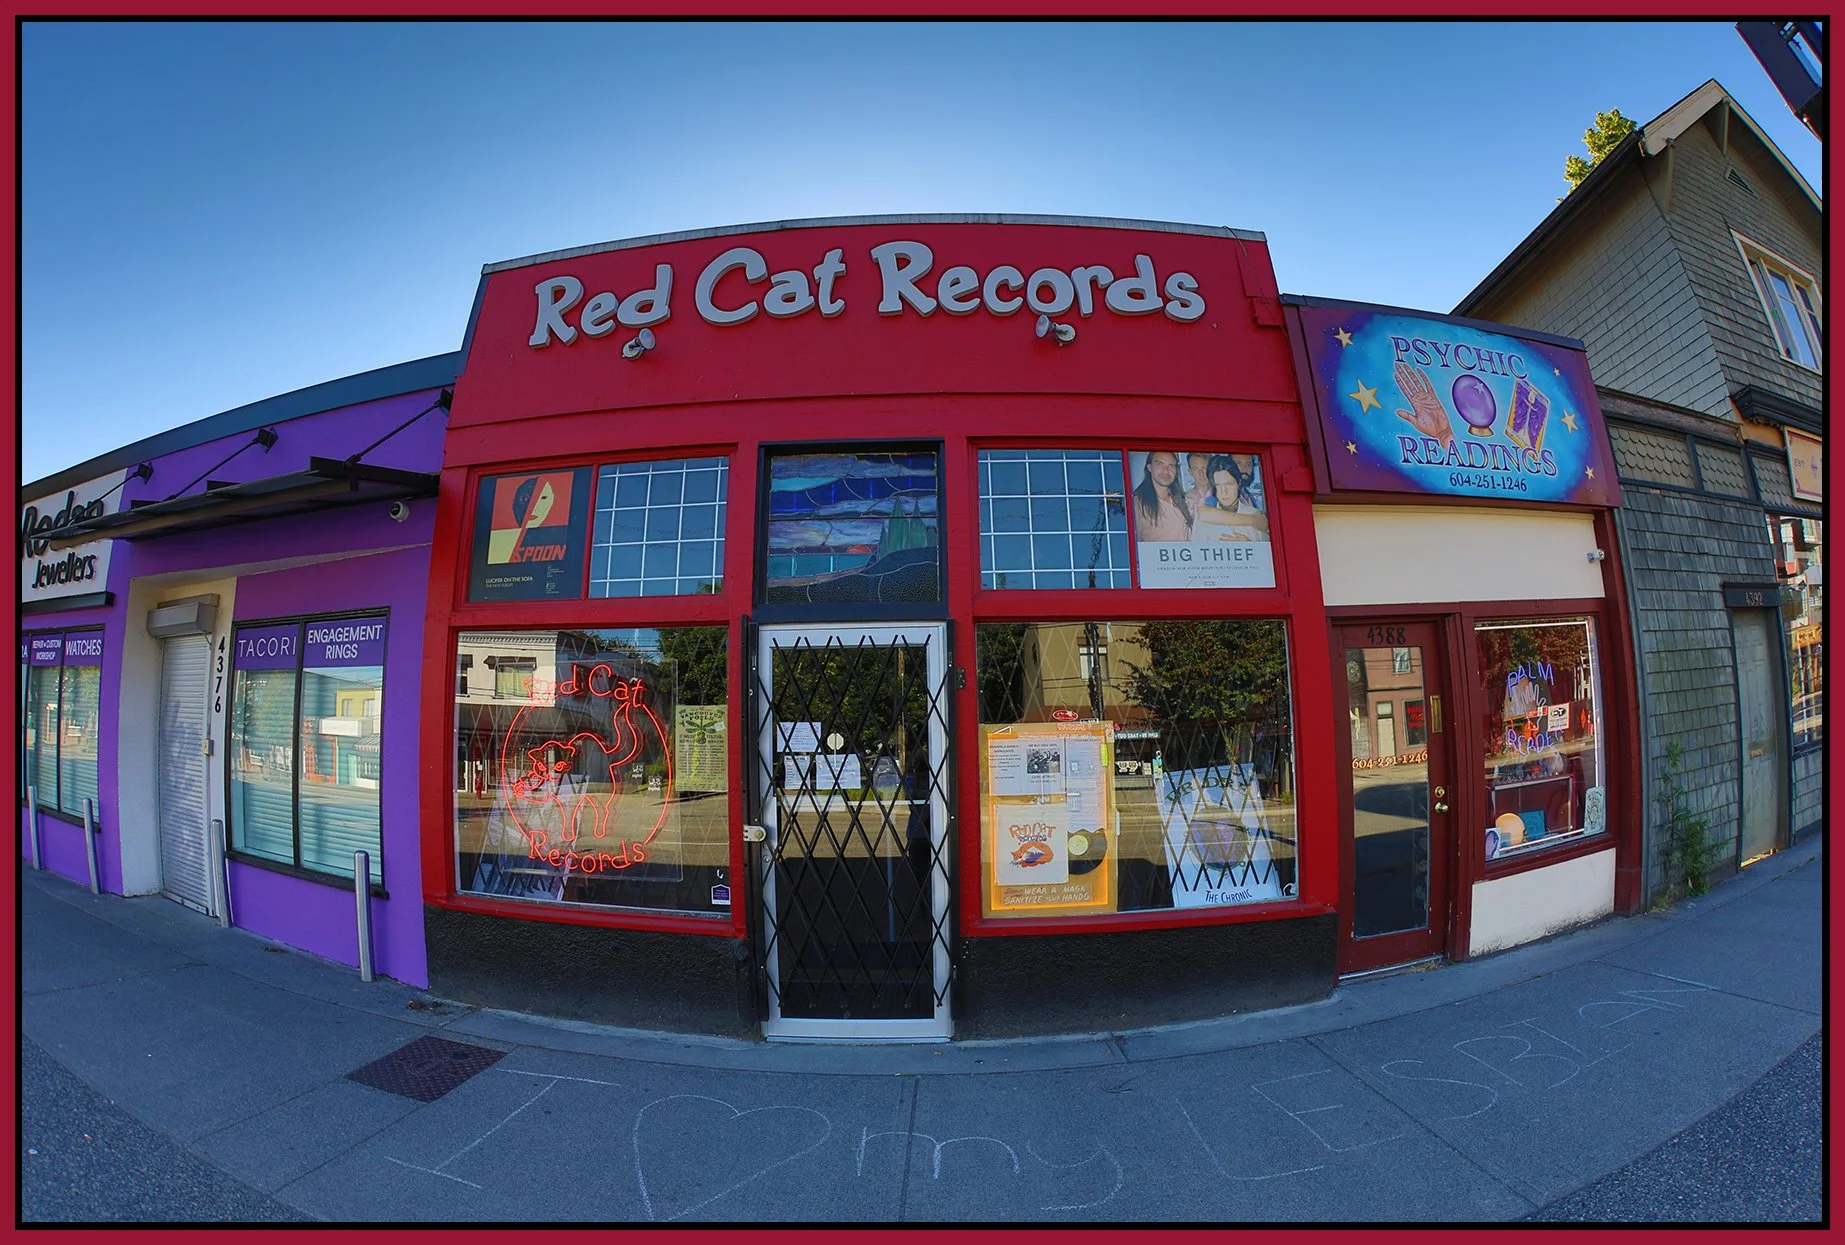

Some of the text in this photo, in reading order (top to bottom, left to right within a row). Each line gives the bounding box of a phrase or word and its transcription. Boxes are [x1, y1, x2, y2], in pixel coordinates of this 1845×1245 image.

[528, 240, 1206, 350] Red Cat Records
[1390, 335, 1528, 380] PSYCHIC
[1396, 435, 1558, 477] READINGS
[1449, 472, 1528, 493] 604-251-1246
[509, 544, 567, 563] SPOON
[1159, 548, 1254, 562] BIG THIEF
[32, 551, 97, 589] Jewellers
[307, 624, 383, 644] ENGAGEMENT
[1367, 625, 1406, 645] 4388
[65, 639, 102, 656] WATCHES
[238, 636, 297, 658] TACORI
[325, 643, 358, 660] RINGS
[214, 636, 225, 713] 4376
[1507, 661, 1555, 698] PALM
[588, 664, 646, 708] Cat
[1352, 750, 1429, 770] 604-251-1246
[528, 829, 646, 874] Records
[1024, 887, 1047, 895] WEAR
[1063, 885, 1086, 893] MASK
[1205, 889, 1253, 904] THE CHRONIC
[856, 1125, 1124, 1212] my
[1175, 971, 1722, 1181] LESBIAN
